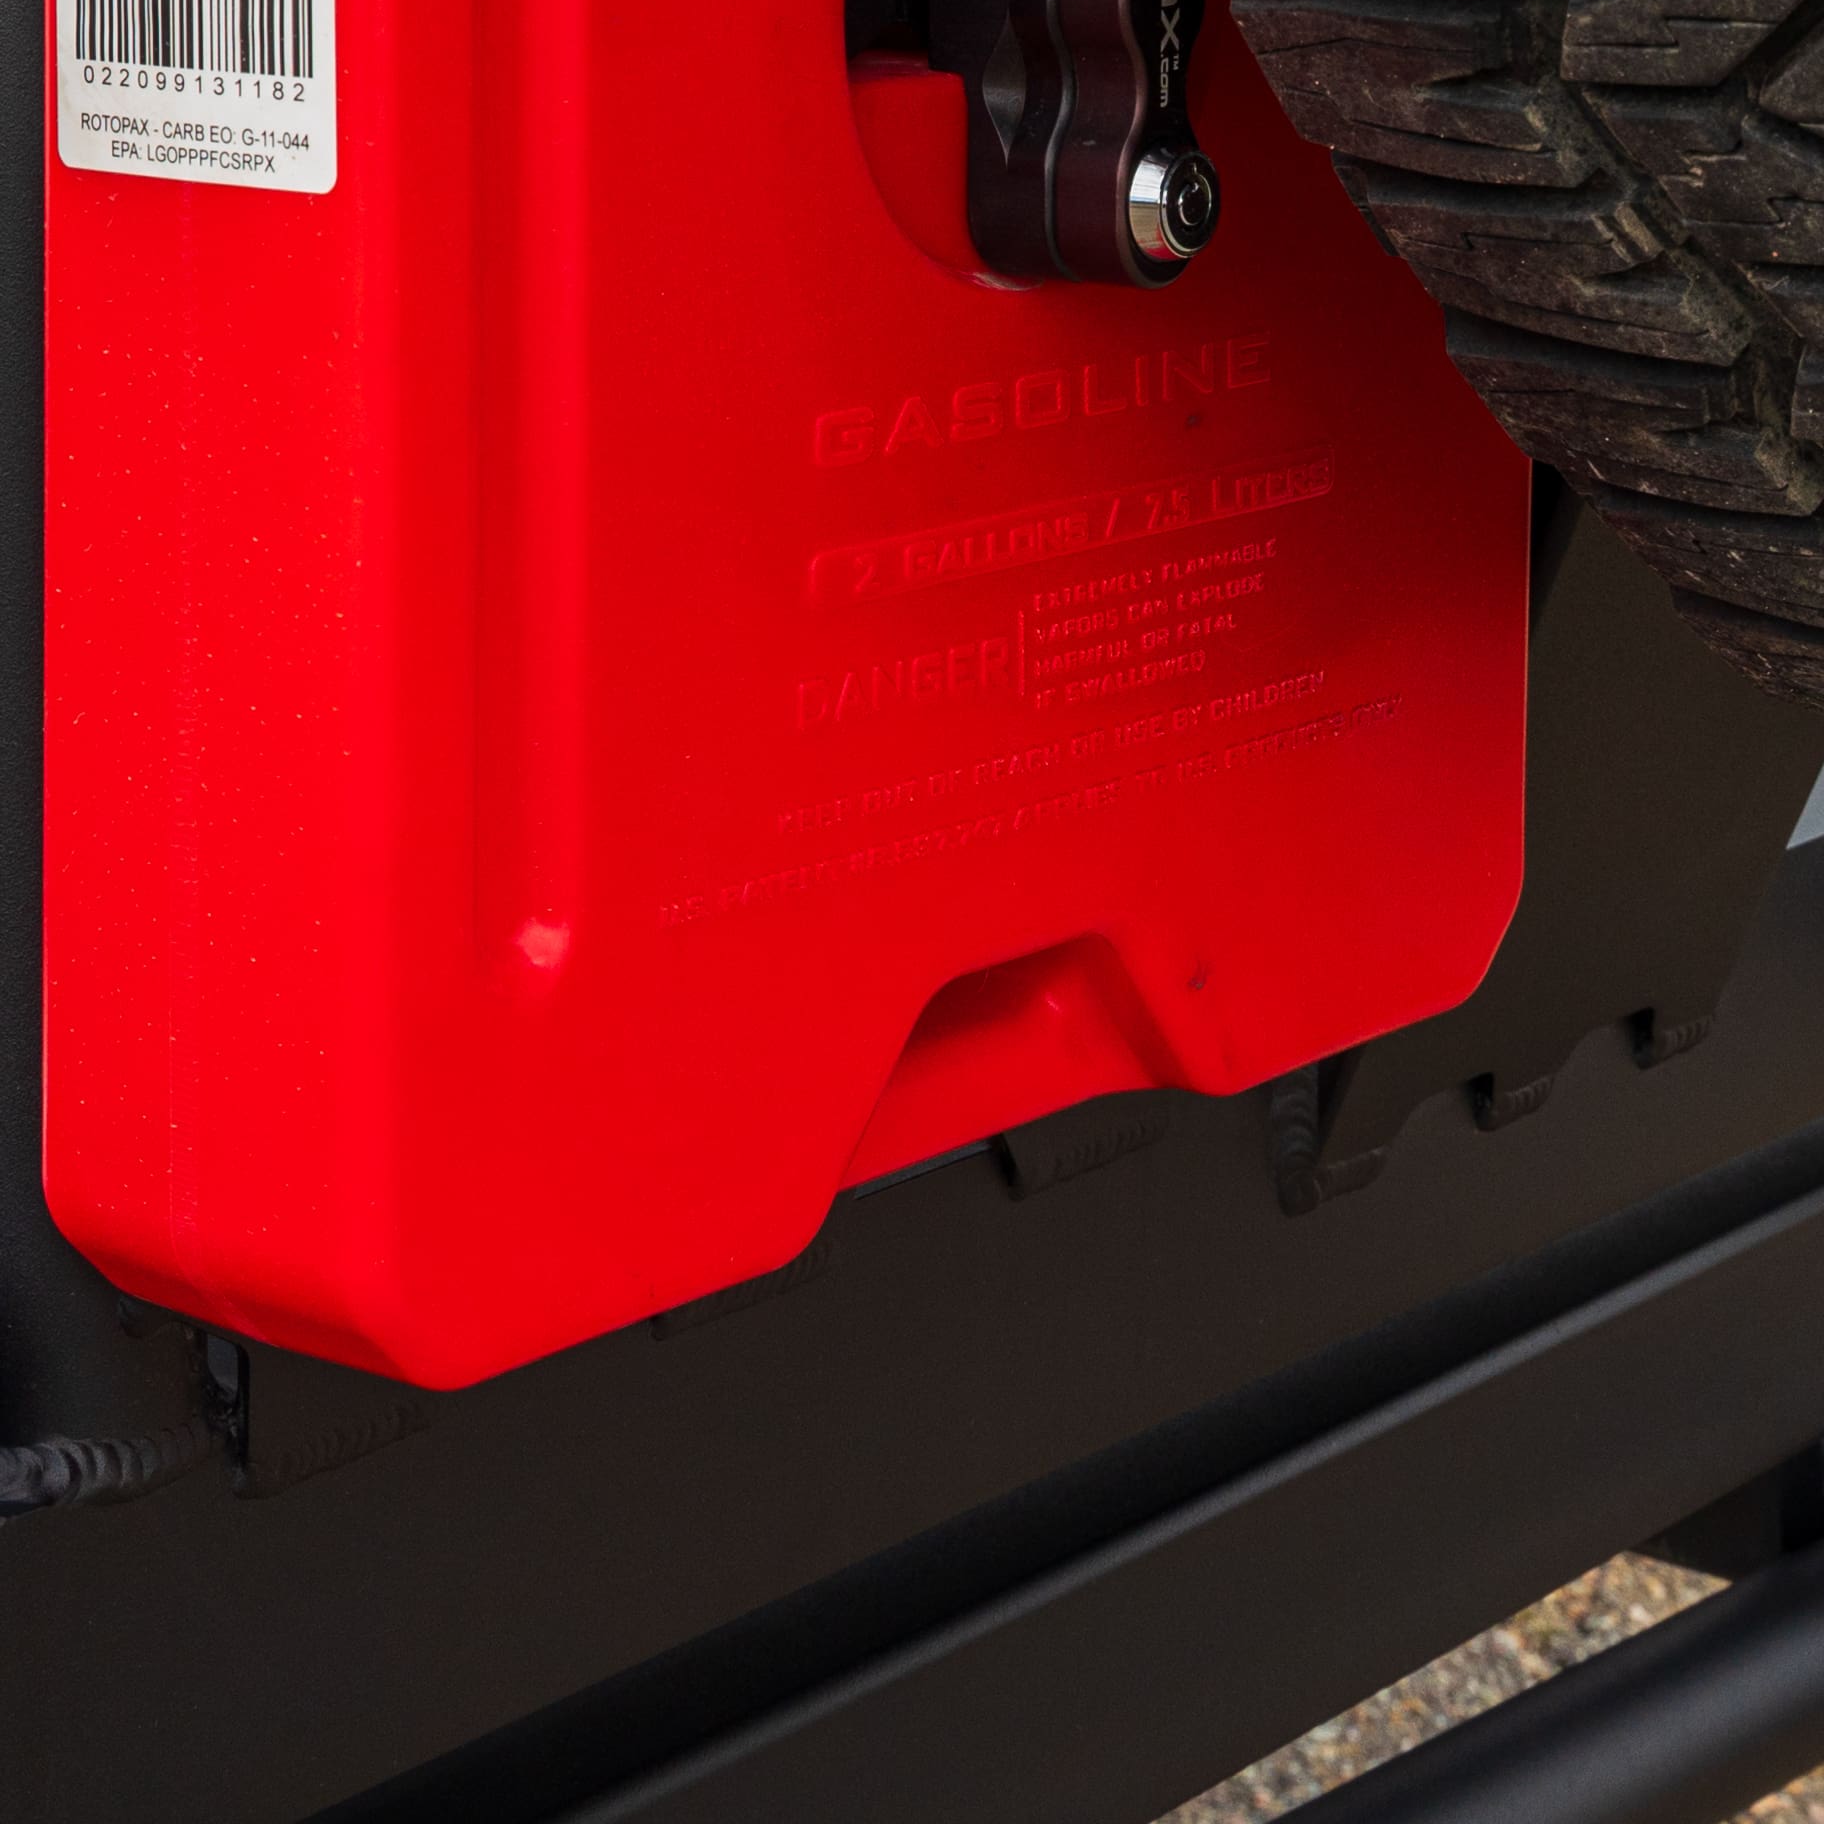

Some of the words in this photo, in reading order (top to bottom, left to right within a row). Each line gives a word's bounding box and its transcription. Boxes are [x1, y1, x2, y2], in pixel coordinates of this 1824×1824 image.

[81, 112, 150, 137] ROTOPAX
[162, 121, 205, 142] CARB
[210, 126, 236, 144] EO:
[242, 129, 310, 151] G-11-044
[111, 141, 142, 160] EPA:
[811, 334, 1272, 469] GASOLINE
[903, 511, 1089, 581] GALLONS
[1210, 458, 1330, 514] LITERS
[1159, 536, 1278, 583] FLAMMABLE
[795, 635, 1010, 734] DANGER
